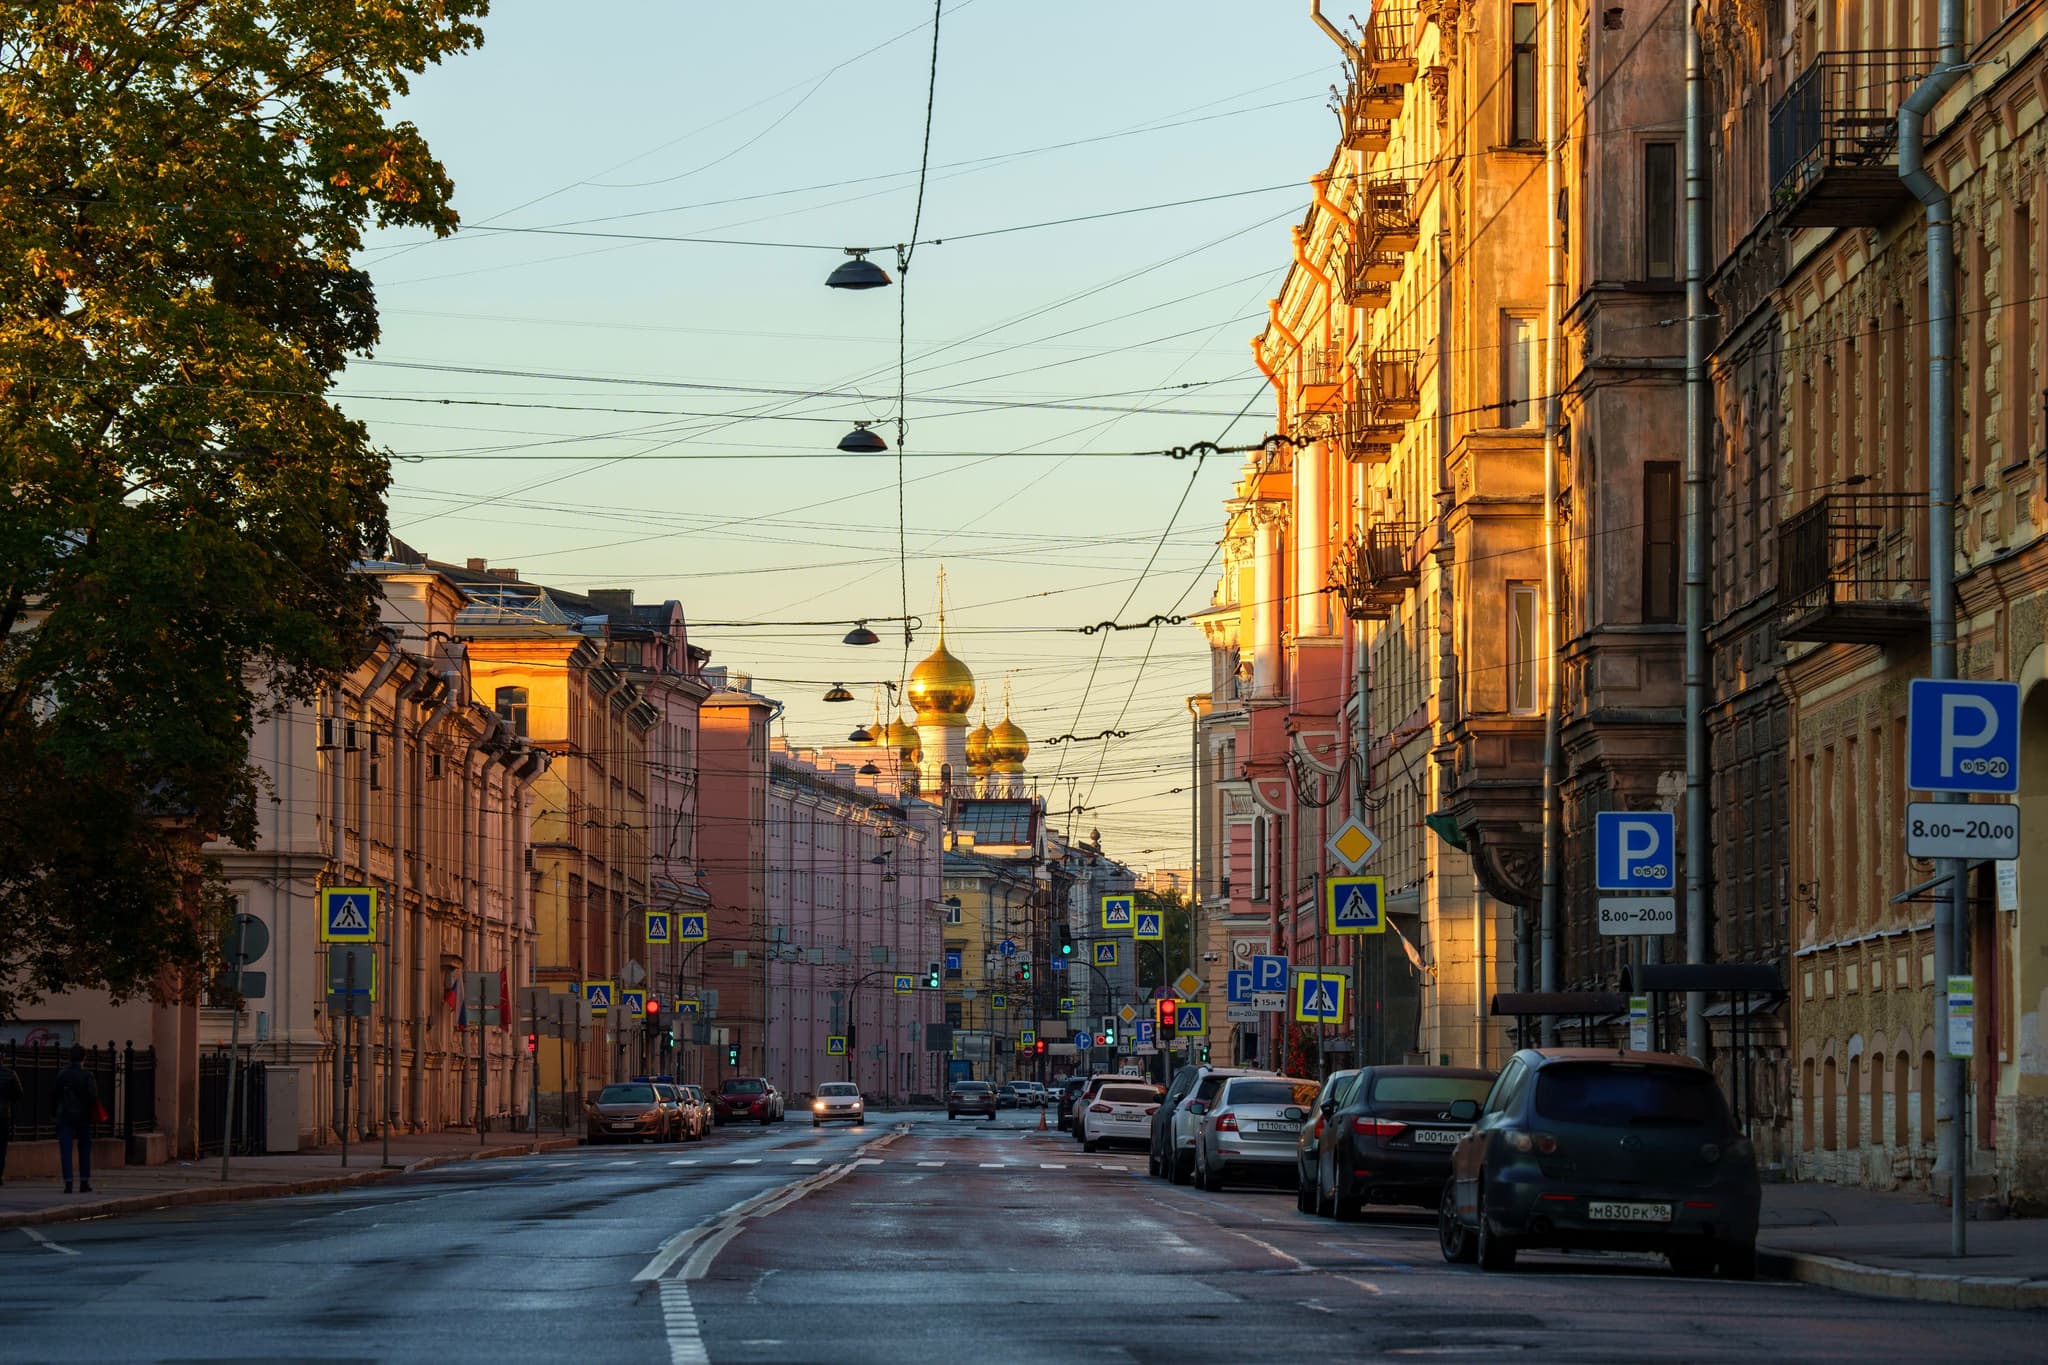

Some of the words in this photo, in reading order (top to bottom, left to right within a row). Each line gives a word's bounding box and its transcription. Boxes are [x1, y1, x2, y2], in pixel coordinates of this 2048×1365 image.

[1939, 693, 1999, 778] P
[1963, 761, 1973, 771] 10
[1974, 761, 1986, 772] 15
[1989, 761, 2008, 774] 20
[1618, 821, 1660, 881] P
[1654, 867, 1666, 877] 20
[1236, 973, 1252, 999] P
[1261, 959, 1282, 987] P
